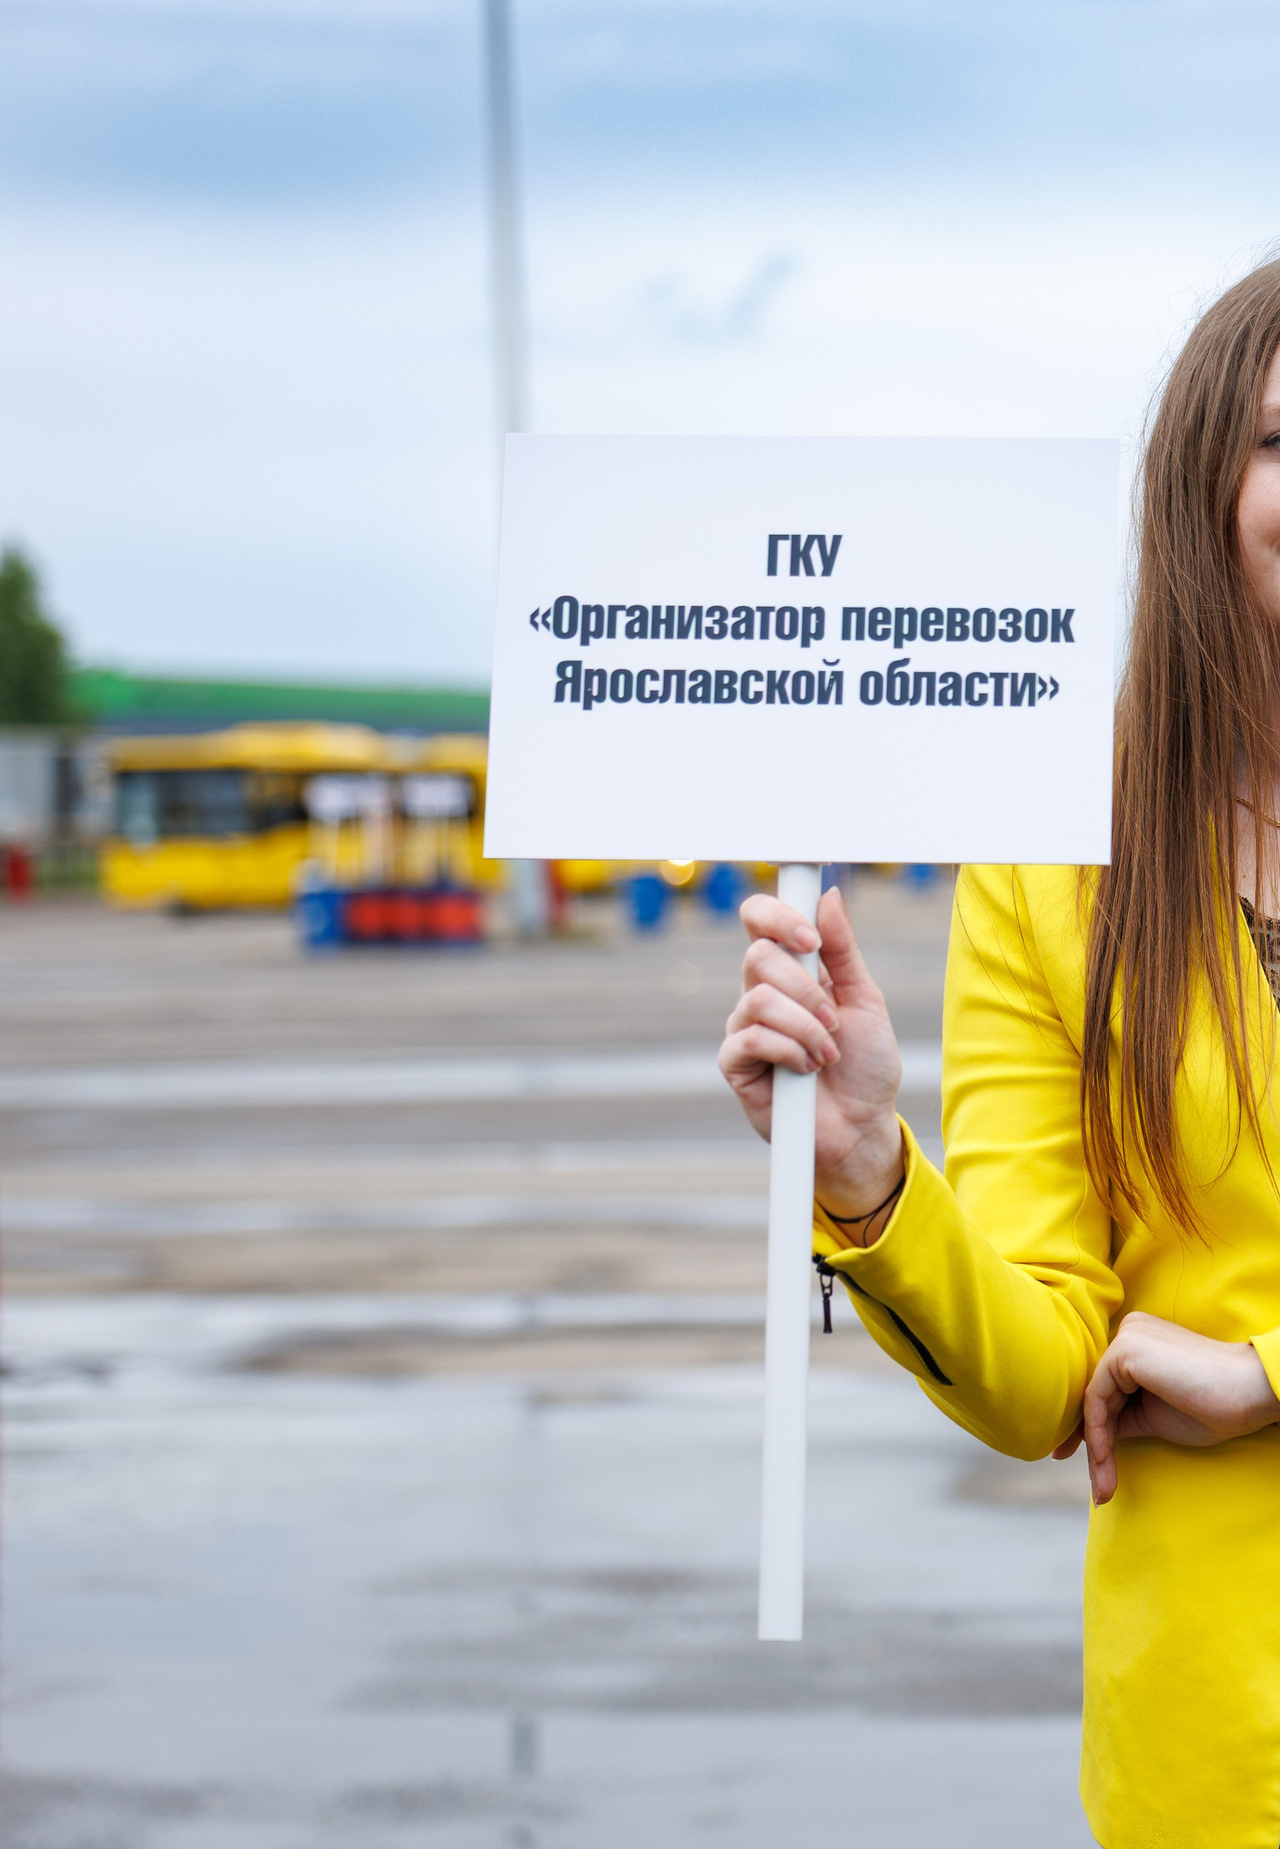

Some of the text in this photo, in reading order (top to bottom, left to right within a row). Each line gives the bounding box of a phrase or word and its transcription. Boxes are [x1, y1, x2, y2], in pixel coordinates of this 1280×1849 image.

[767, 534, 843, 577] ГКУ
[529, 595, 1075, 649] «Организатор перевозок
[553, 657, 1060, 711] Ярославской области»
